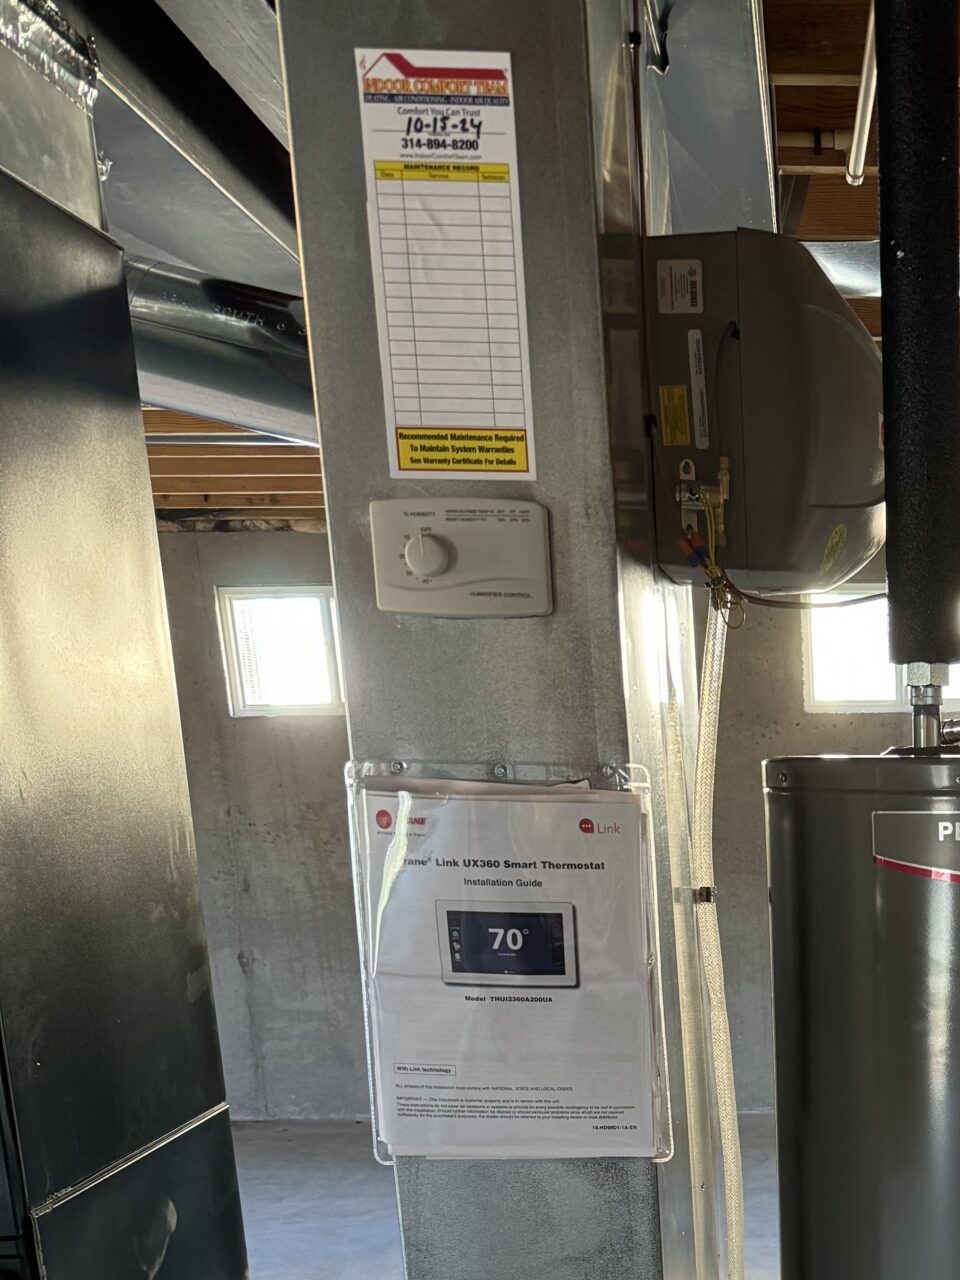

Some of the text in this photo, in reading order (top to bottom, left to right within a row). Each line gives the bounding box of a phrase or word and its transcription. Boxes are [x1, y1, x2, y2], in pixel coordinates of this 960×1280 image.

[363, 78, 507, 95] INDOOR COMFORT TEAM
[430, 108, 444, 116] You
[462, 108, 480, 116] Trust
[406, 117, 482, 139] 10-15-24
[401, 138, 478, 150] 314-894-8200
[495, 434, 524, 443] Required
[451, 446, 476, 454] System
[597, 822, 621, 834] Link
[436, 858, 459, 868] Link
[463, 859, 500, 868] UX360
[503, 860, 537, 869] Smart
[541, 861, 605, 870] Thermostat
[464, 877, 542, 888] Installation Guide
